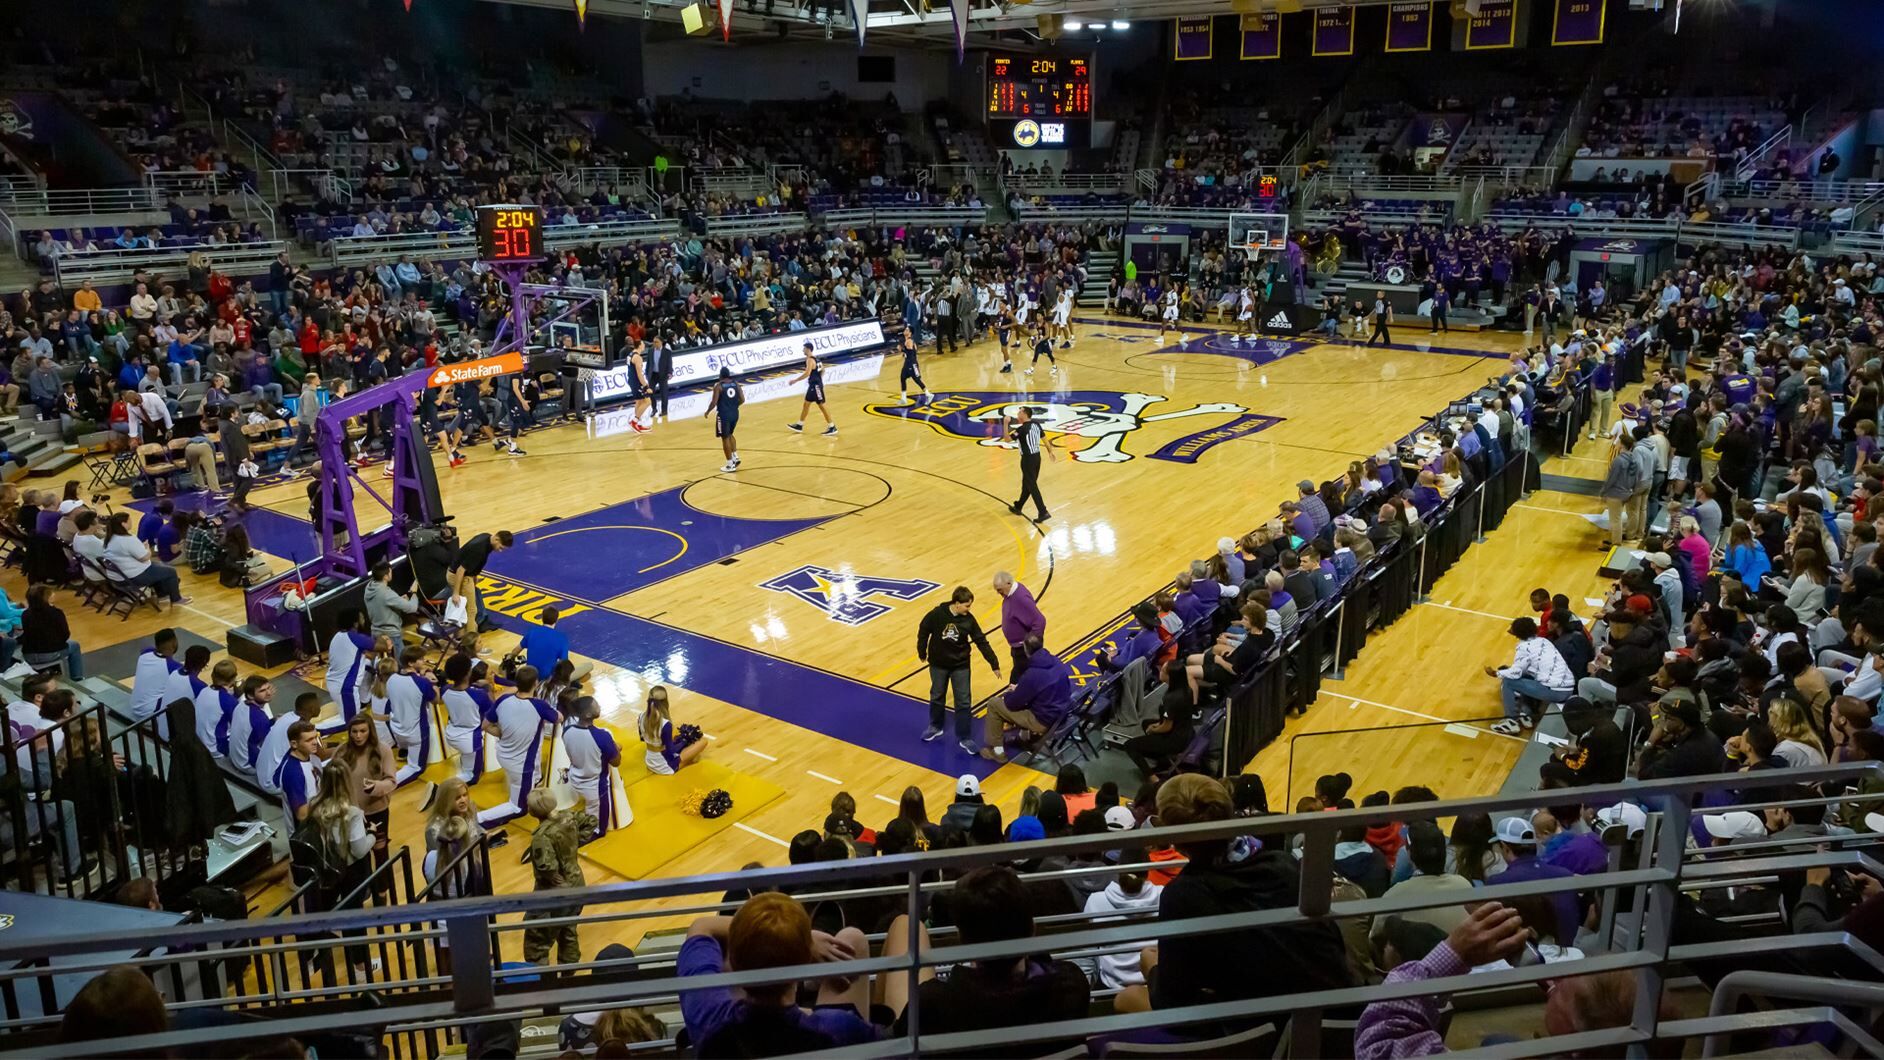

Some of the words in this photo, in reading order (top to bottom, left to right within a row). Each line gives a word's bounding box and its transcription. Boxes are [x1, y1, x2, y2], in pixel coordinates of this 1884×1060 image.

[995, 65, 1007, 75] 22
[1031, 60, 1056, 73] 2:04
[1075, 66, 1087, 76] 29
[1021, 90, 1027, 99] 4
[1053, 90, 1059, 99] 4
[1024, 104, 1030, 114] 6
[1056, 104, 1061, 114] 6
[1260, 176, 1277, 185] 2:04
[1259, 184, 1274, 197] 30
[496, 212, 534, 228] 2:04
[494, 228, 530, 256] 30
[1267, 321, 1292, 329] adidas
[814, 334, 836, 350] ECU
[838, 329, 878, 348] Physicians
[718, 350, 745, 368] ECU
[746, 344, 794, 364] Physicians
[726, 388, 736, 398] 0
[910, 395, 982, 418] ECU
